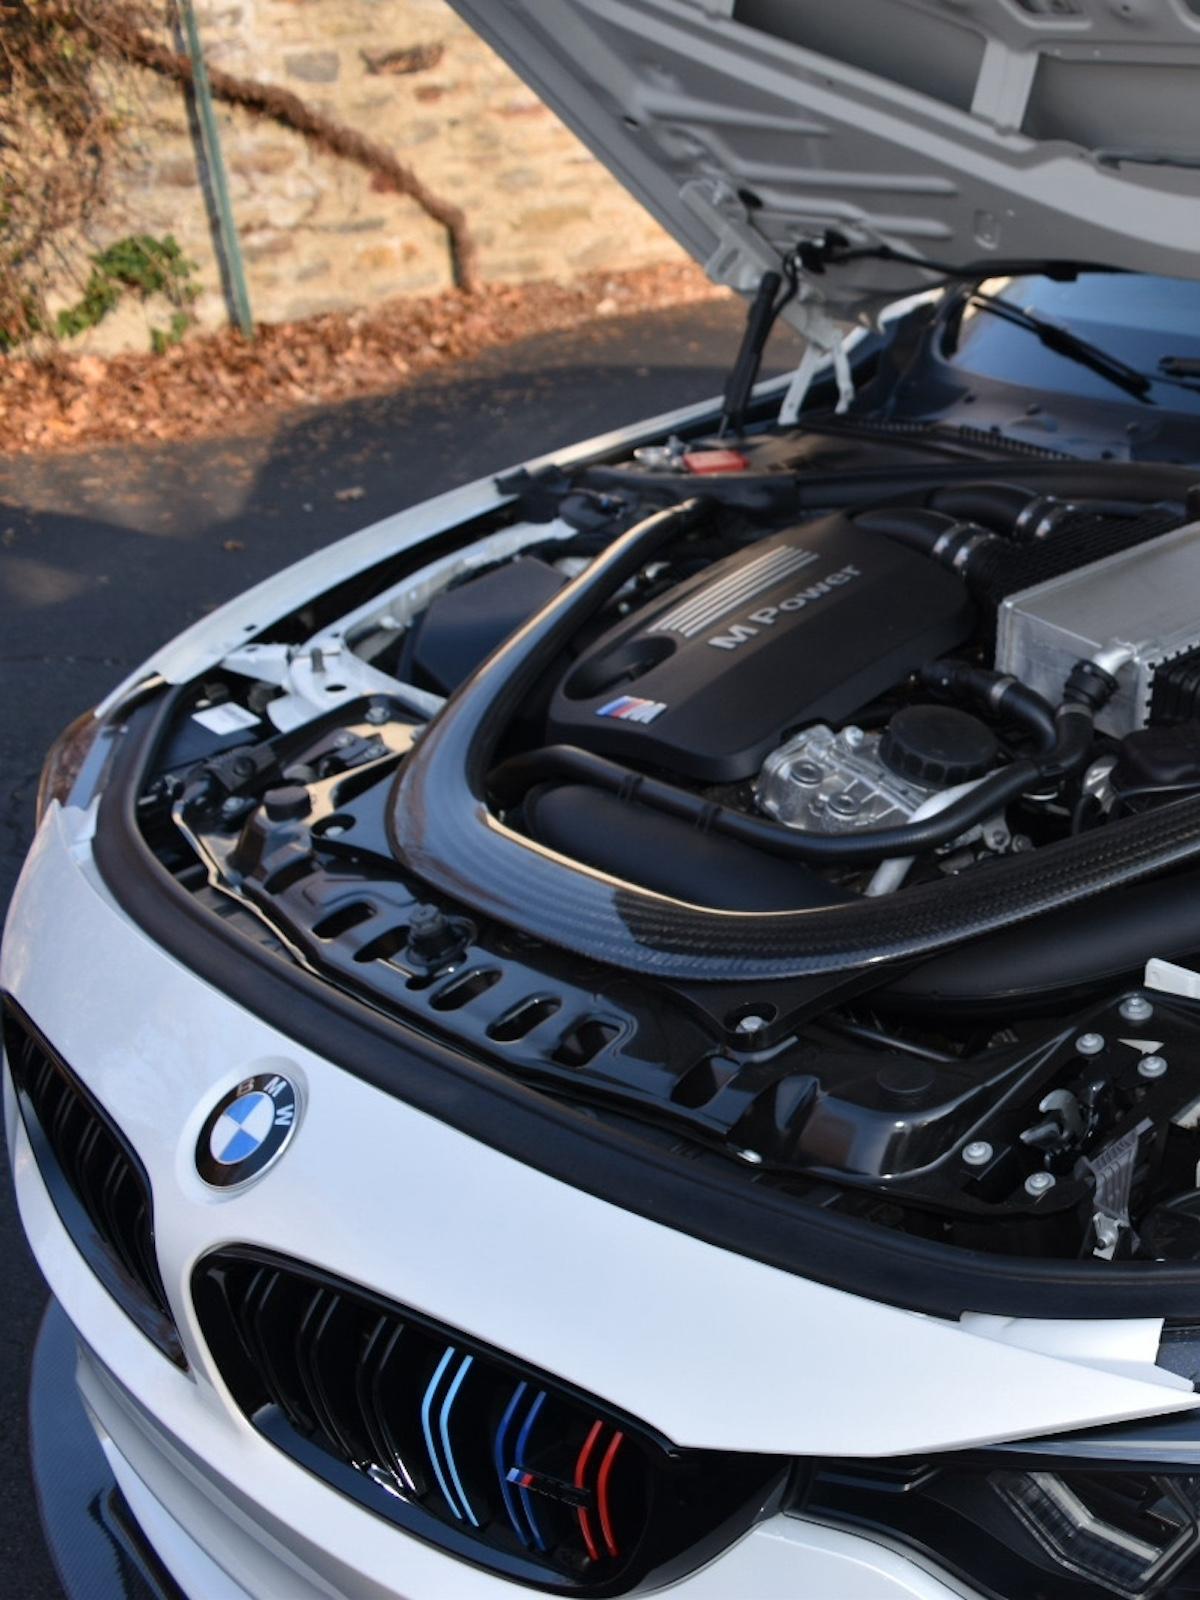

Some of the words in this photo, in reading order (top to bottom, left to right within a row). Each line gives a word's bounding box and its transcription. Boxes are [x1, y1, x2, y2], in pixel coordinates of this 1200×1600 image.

[708, 623, 759, 649] M
[748, 564, 862, 625] Power
[235, 1075, 295, 1126] BMW
